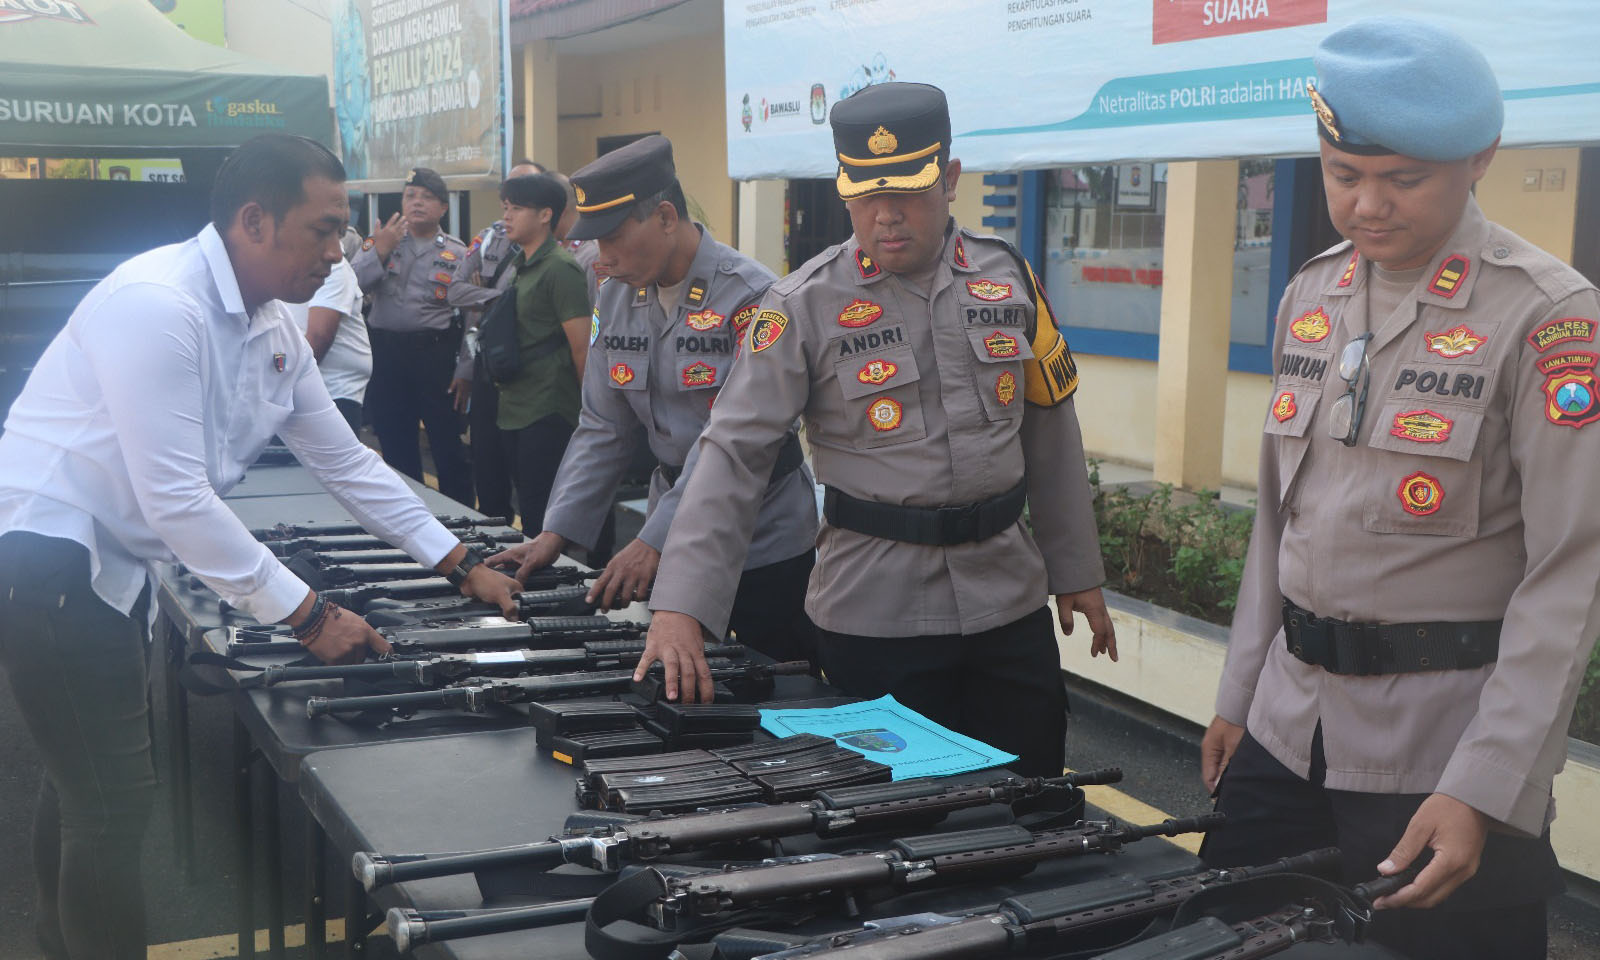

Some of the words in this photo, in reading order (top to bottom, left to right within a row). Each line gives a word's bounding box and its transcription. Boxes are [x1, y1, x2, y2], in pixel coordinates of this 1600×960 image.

[1007, 13, 1065, 32] PENGHITUNGAN
[1066, 9, 1092, 24] SUARA
[1203, 0, 1269, 26] SUARA
[372, 23, 401, 56] DALAM
[403, 3, 462, 46] MENGAWAL
[373, 48, 421, 95] PEMILU
[425, 36, 463, 85] 2024
[408, 86, 429, 117] DAN
[432, 81, 465, 113] DAMAI
[1099, 90, 1167, 114] Netralitas
[1170, 86, 1216, 109] POLRI
[1219, 78, 1274, 105] adalah
[1278, 75, 1320, 100] HAR
[0, 98, 114, 125] SURUAN
[123, 103, 197, 127] KOTA
[770, 101, 801, 115] BAWASLU
[966, 307, 1019, 325] POLRI
[839, 326, 903, 357] ANDRI
[1536, 321, 1589, 340] POLRES
[1539, 330, 1571, 348] PASURUAN
[1572, 328, 1590, 338] KOTA
[603, 335, 649, 352] SOLEH
[676, 336, 729, 353] POLRI
[1544, 357, 1567, 369] JAWA
[1567, 355, 1592, 365] TIMUR
[1395, 369, 1485, 400] POLRI
